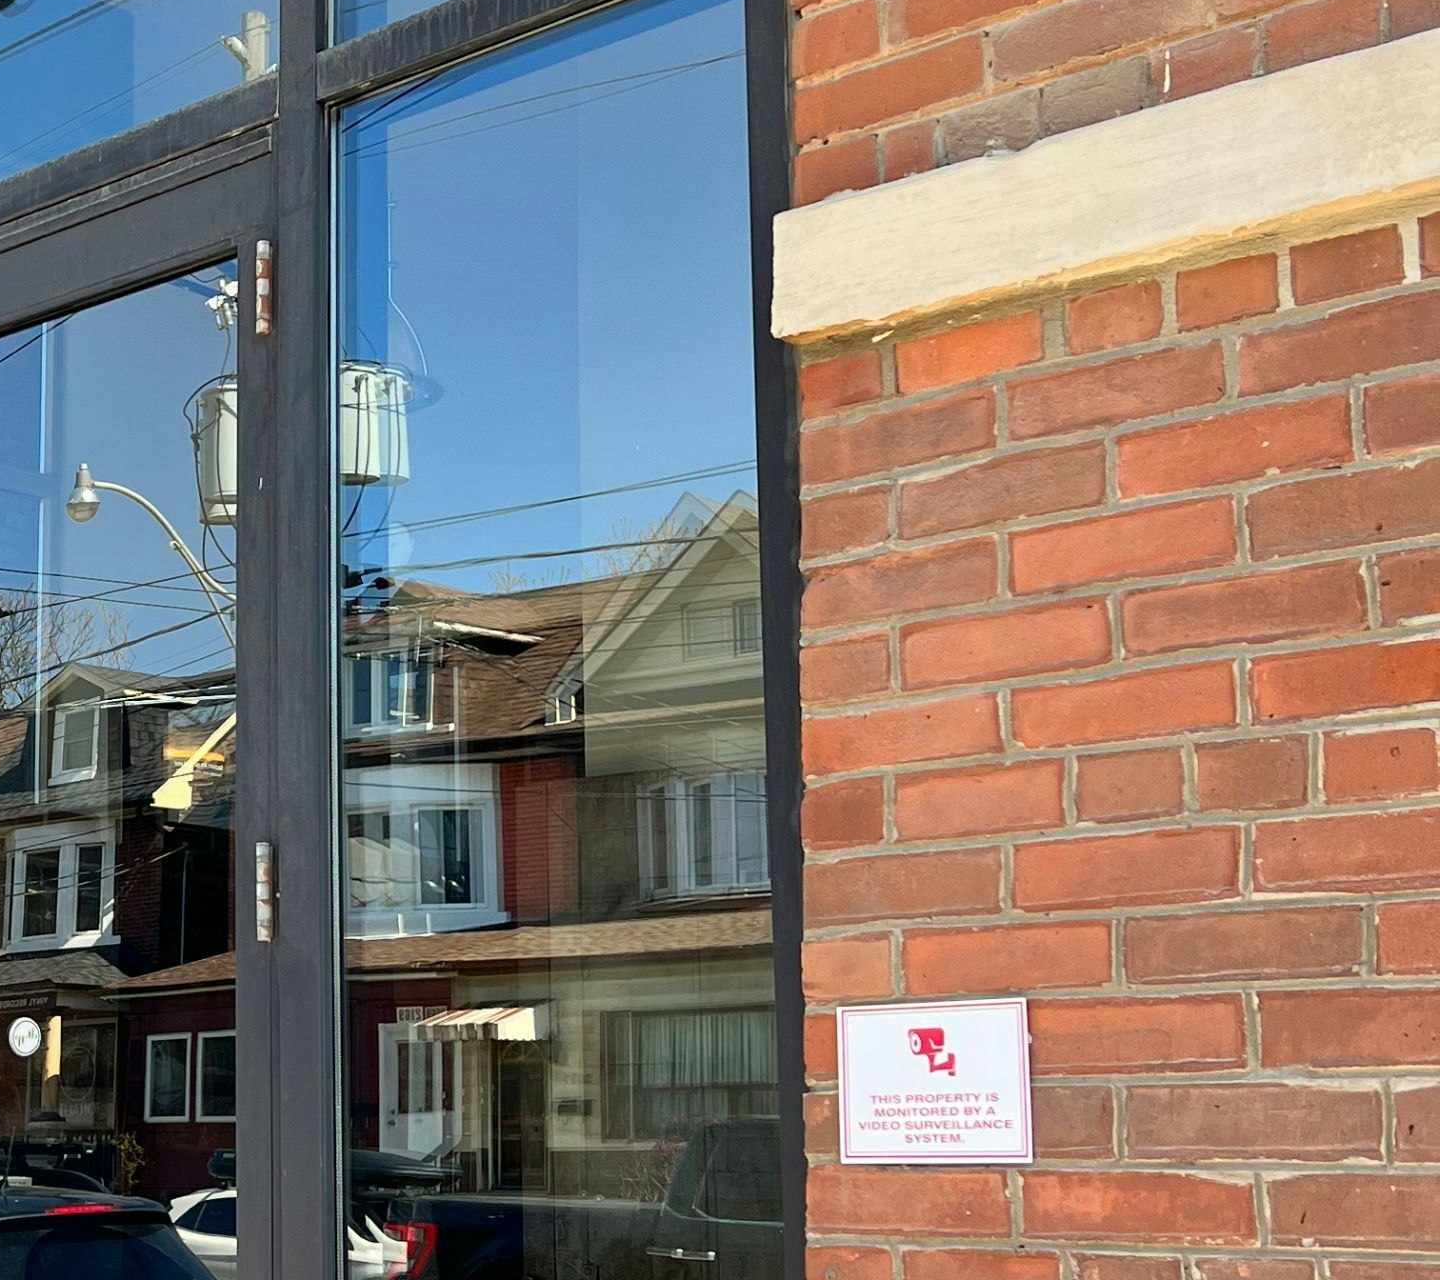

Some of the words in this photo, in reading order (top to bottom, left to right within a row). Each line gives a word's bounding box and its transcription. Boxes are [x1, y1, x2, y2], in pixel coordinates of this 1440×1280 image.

[870, 1094, 901, 1104] THIS
[905, 1093, 981, 1103] PROPERTY
[985, 1092, 1000, 1102] IS
[874, 1107, 959, 1117] MONITORED
[963, 1106, 981, 1116] BY
[985, 1106, 996, 1115] A
[858, 1121, 901, 1131] VIDEO
[904, 1119, 1014, 1130] SURVEILLANCE
[904, 1133, 966, 1144] SYSTEM.
